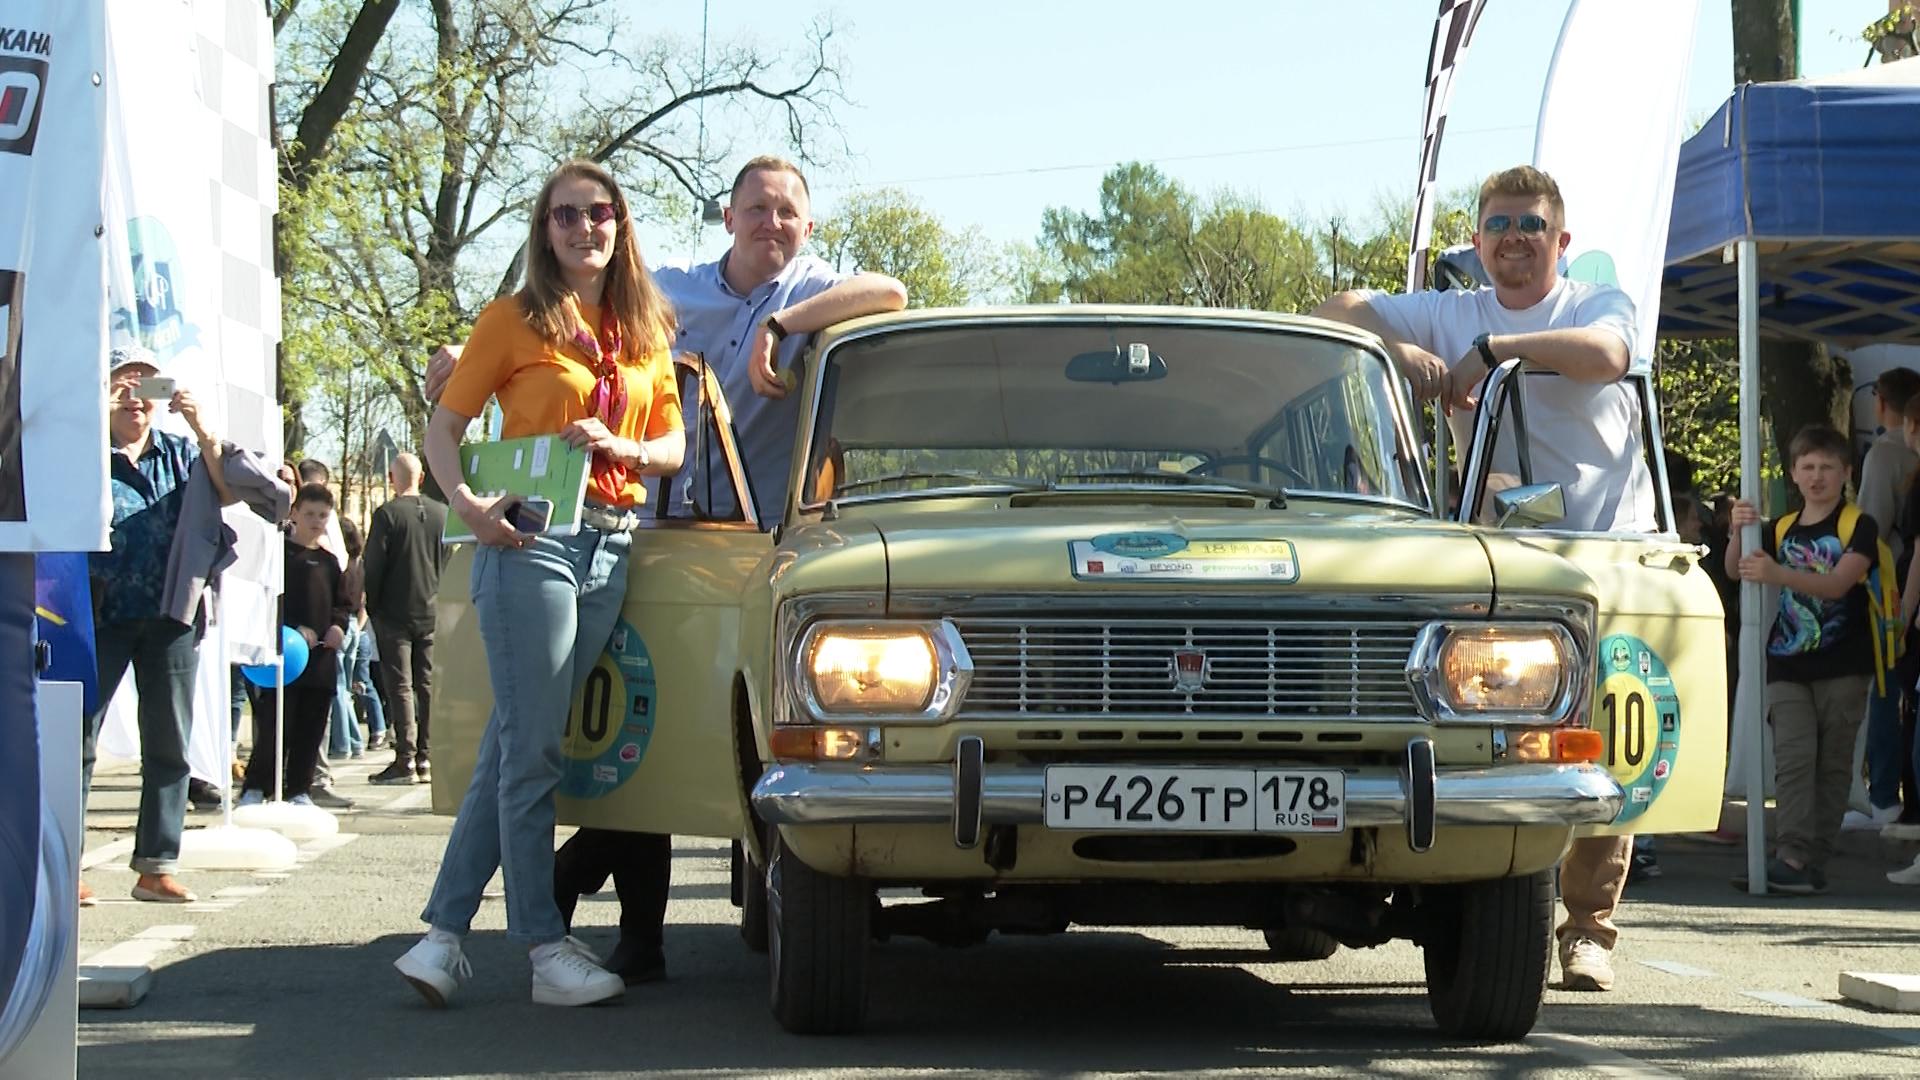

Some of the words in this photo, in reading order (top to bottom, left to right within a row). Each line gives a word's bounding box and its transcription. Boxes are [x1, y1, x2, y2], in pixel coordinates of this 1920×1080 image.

[1602, 691, 1645, 767] 10
[1261, 776, 1330, 812] 178
[1275, 813, 1311, 826] RUS
